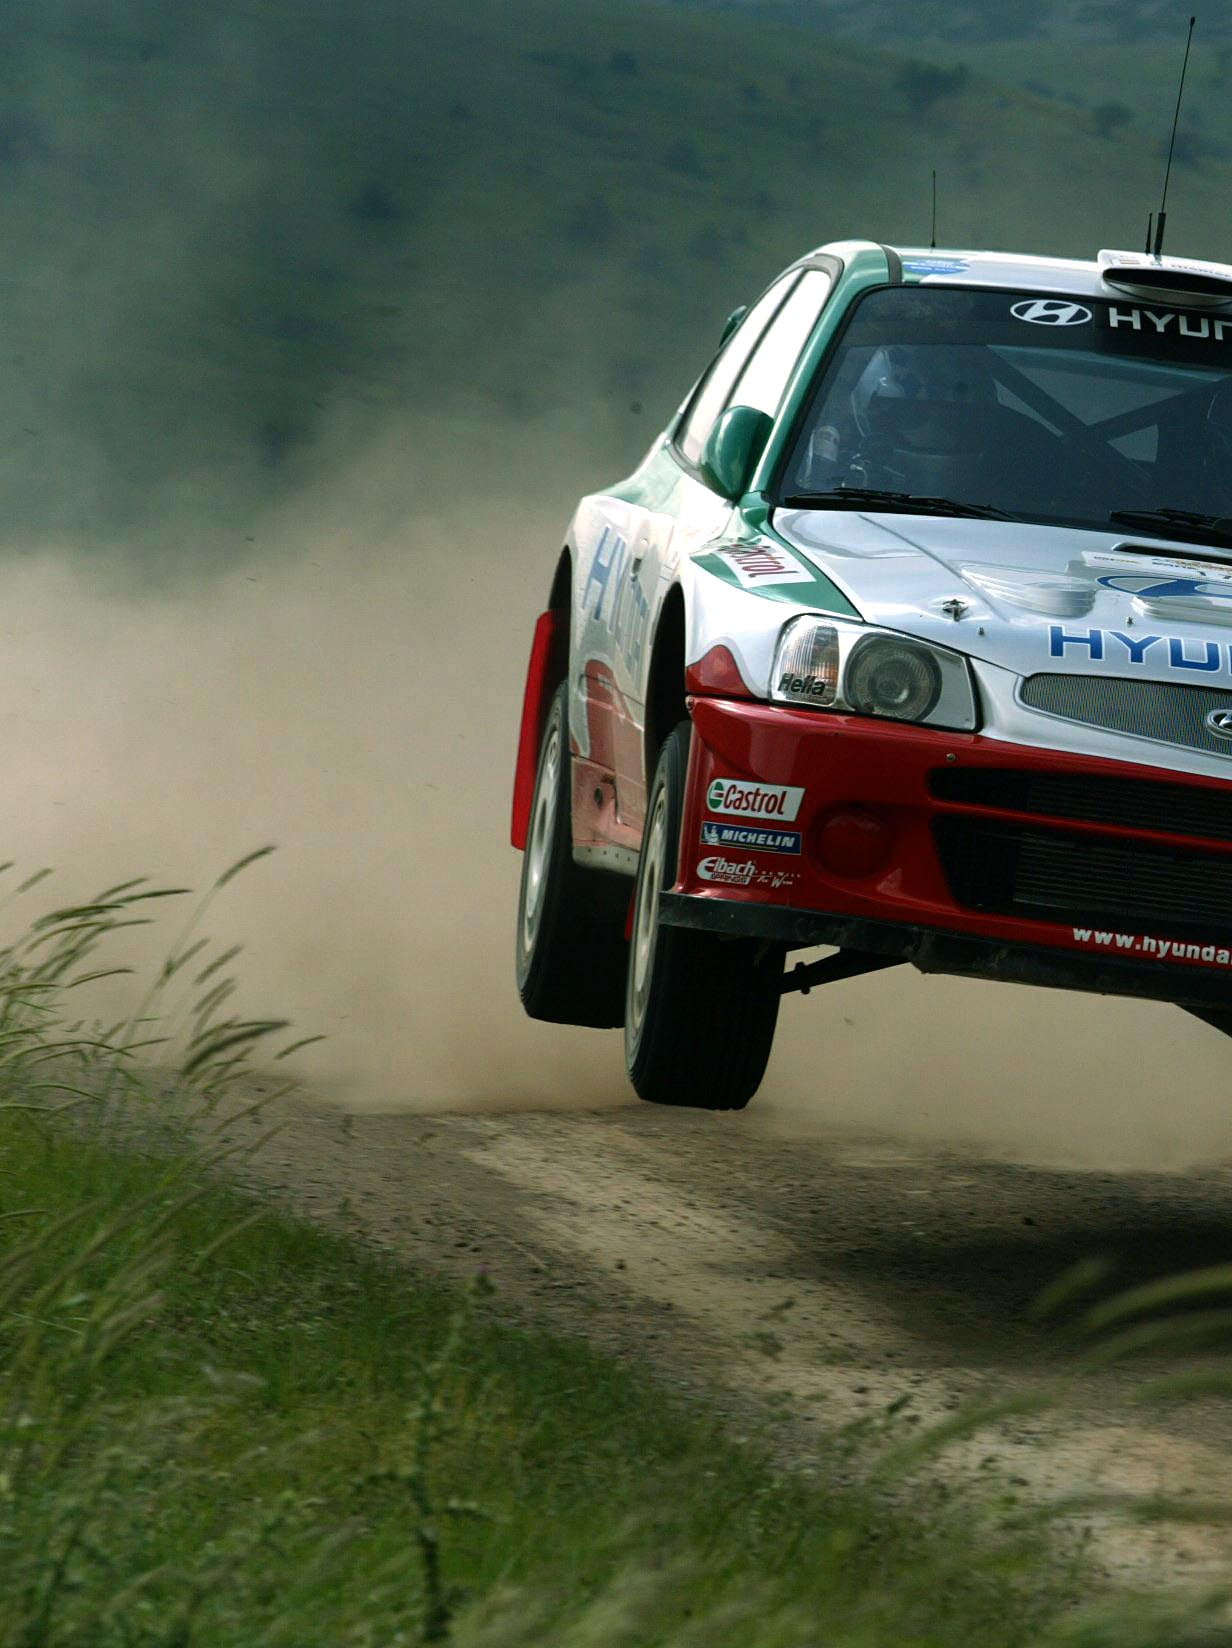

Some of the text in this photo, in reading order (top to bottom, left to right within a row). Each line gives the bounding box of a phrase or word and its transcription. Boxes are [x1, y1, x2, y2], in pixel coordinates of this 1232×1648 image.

[777, 673, 827, 697] Hella
[723, 784, 788, 815] Castrol
[721, 829, 796, 848] MICHELIN
